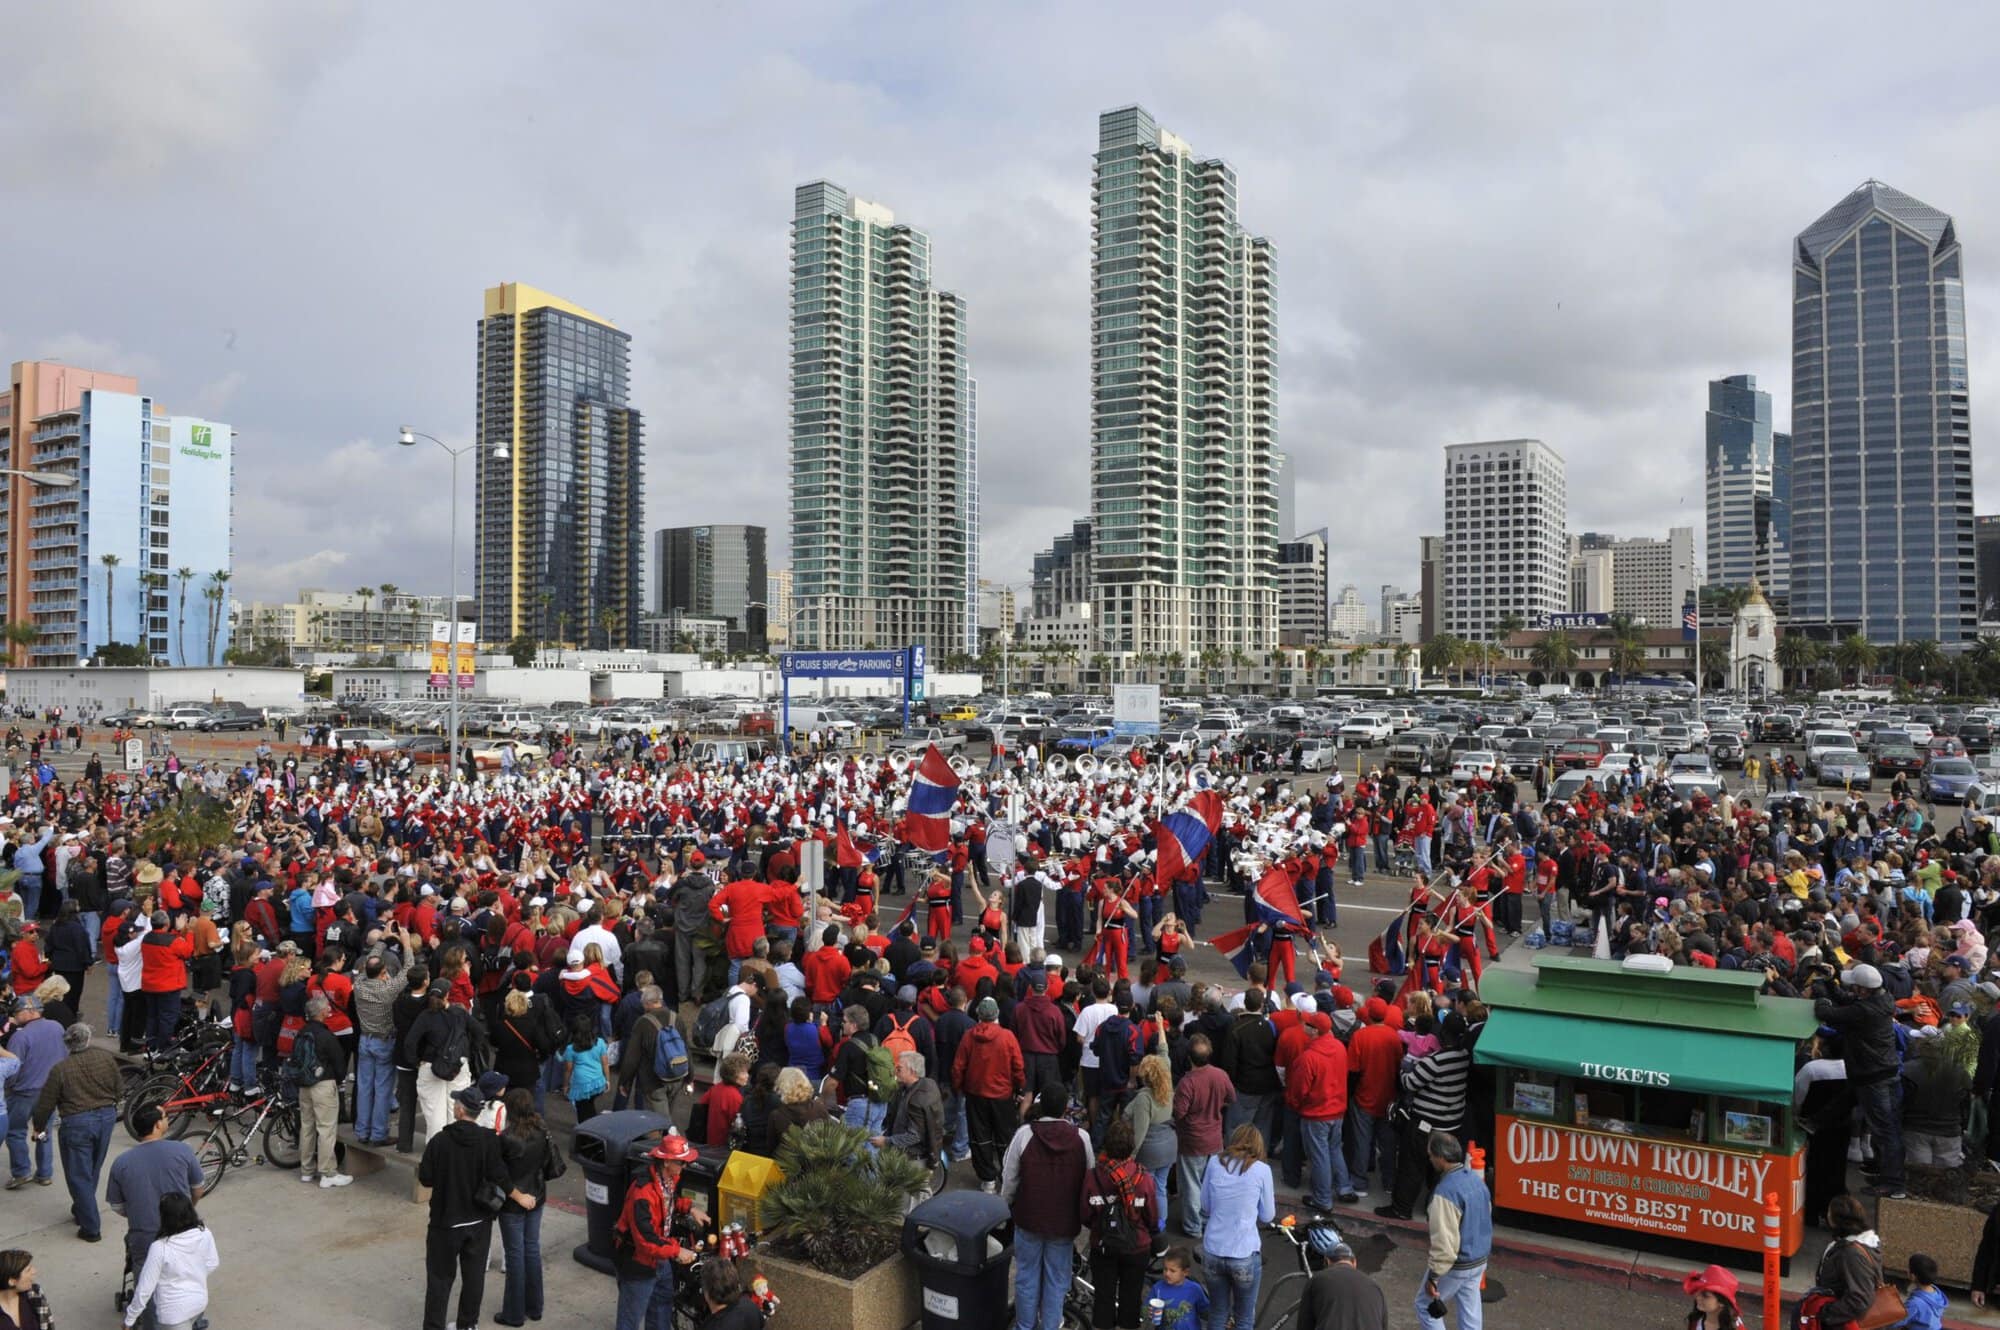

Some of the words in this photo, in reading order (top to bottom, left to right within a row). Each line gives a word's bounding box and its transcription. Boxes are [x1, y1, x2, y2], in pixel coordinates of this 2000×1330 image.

[181, 446, 209, 460] Holiday
[210, 450, 222, 460] Inn
[1540, 614, 1596, 627] Santa
[786, 656, 793, 667] 5
[795, 660, 821, 670] CRUISE
[822, 660, 839, 670] SHIP
[858, 660, 891, 670] PARKING
[895, 655, 903, 666] 5
[914, 647, 924, 667] 5
[914, 683, 922, 697] P
[1580, 1062, 1670, 1087] TICKETS
[1507, 1122, 1560, 1165] OLD
[1565, 1131, 1640, 1167] TOWN
[1649, 1143, 1773, 1204] TROLLEY
[1567, 1165, 1591, 1182] SAN
[1593, 1168, 1629, 1189] DIEGO
[1631, 1175, 1641, 1190] &
[1643, 1177, 1710, 1201] CORONADO
[1518, 1178, 1560, 1200] THE
[1565, 1186, 1628, 1212] CITY'S
[1634, 1197, 1691, 1222] BEST
[1699, 1208, 1756, 1234] TOUR
[1585, 1209, 1687, 1233] www.trolleytours.com
